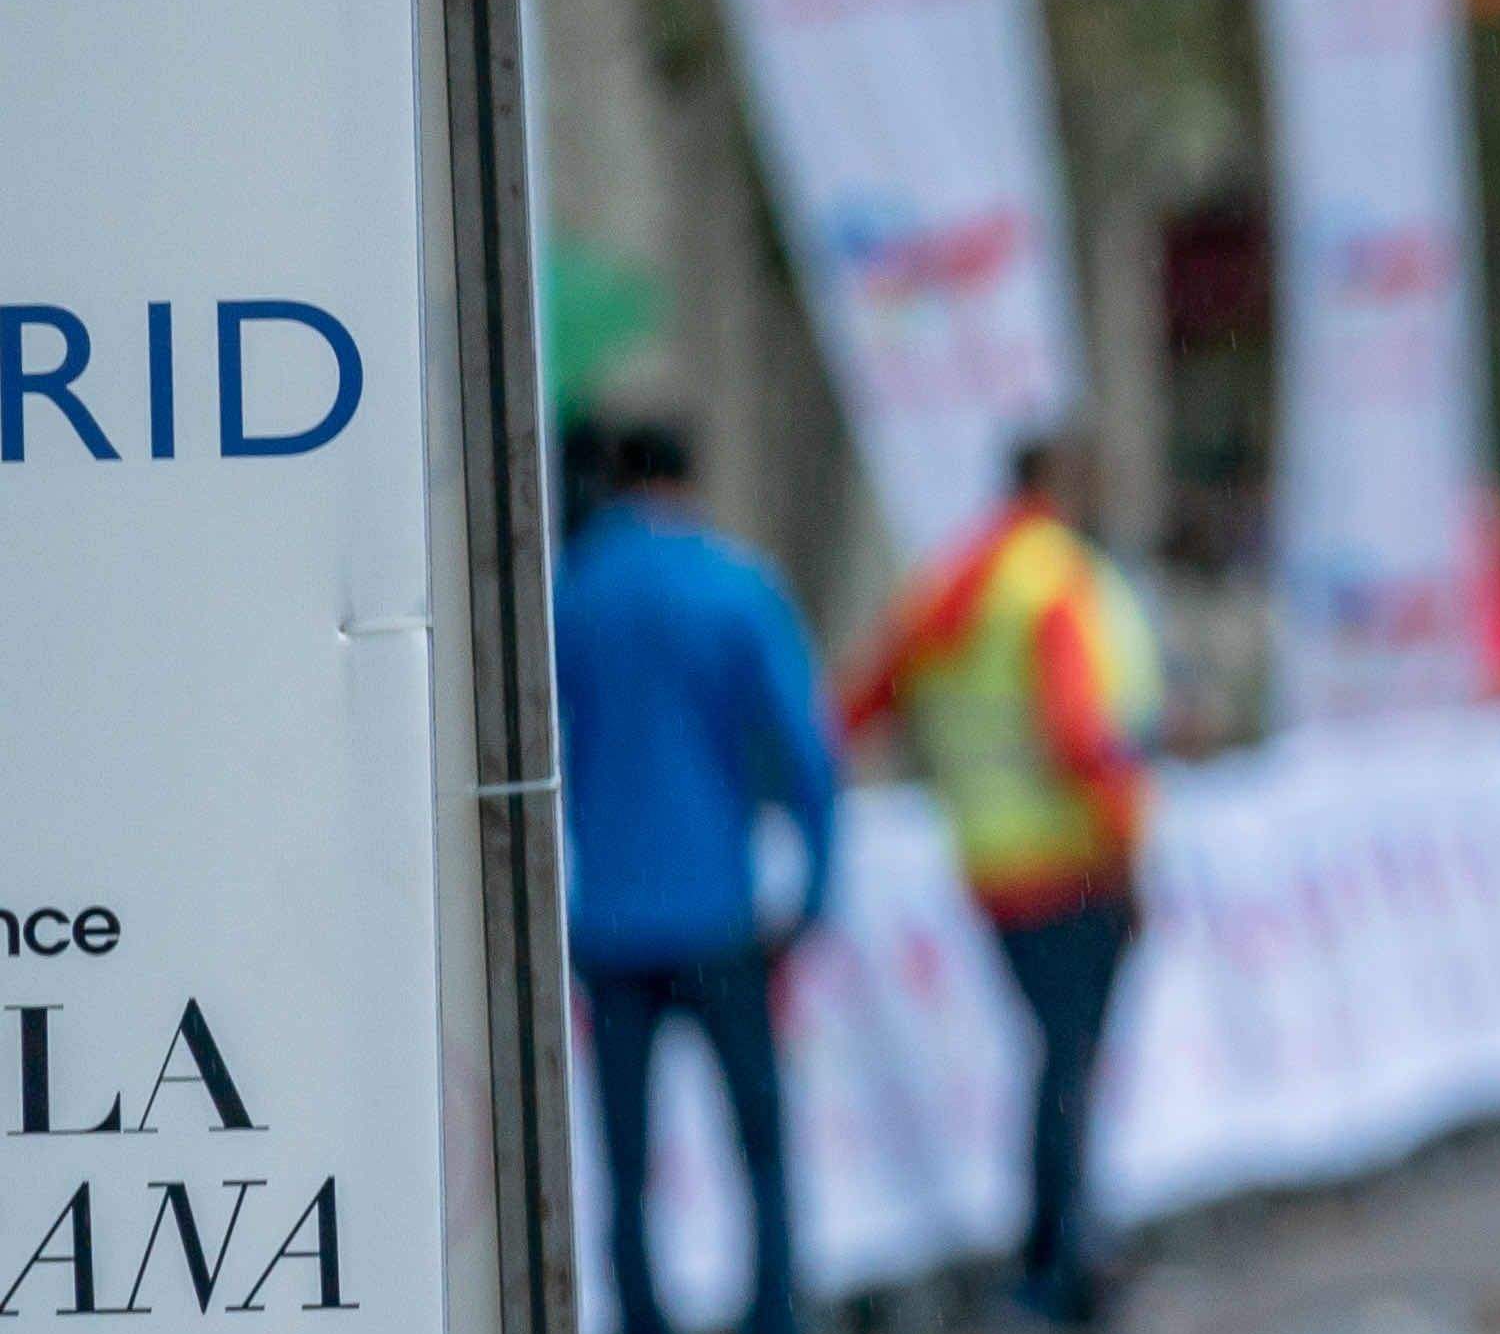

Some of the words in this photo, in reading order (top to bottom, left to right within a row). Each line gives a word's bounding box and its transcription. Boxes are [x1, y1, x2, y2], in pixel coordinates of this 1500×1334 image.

[0, 300, 364, 462] RID
[5, 996, 270, 1137] LA
[0, 1175, 360, 1314] ANA
